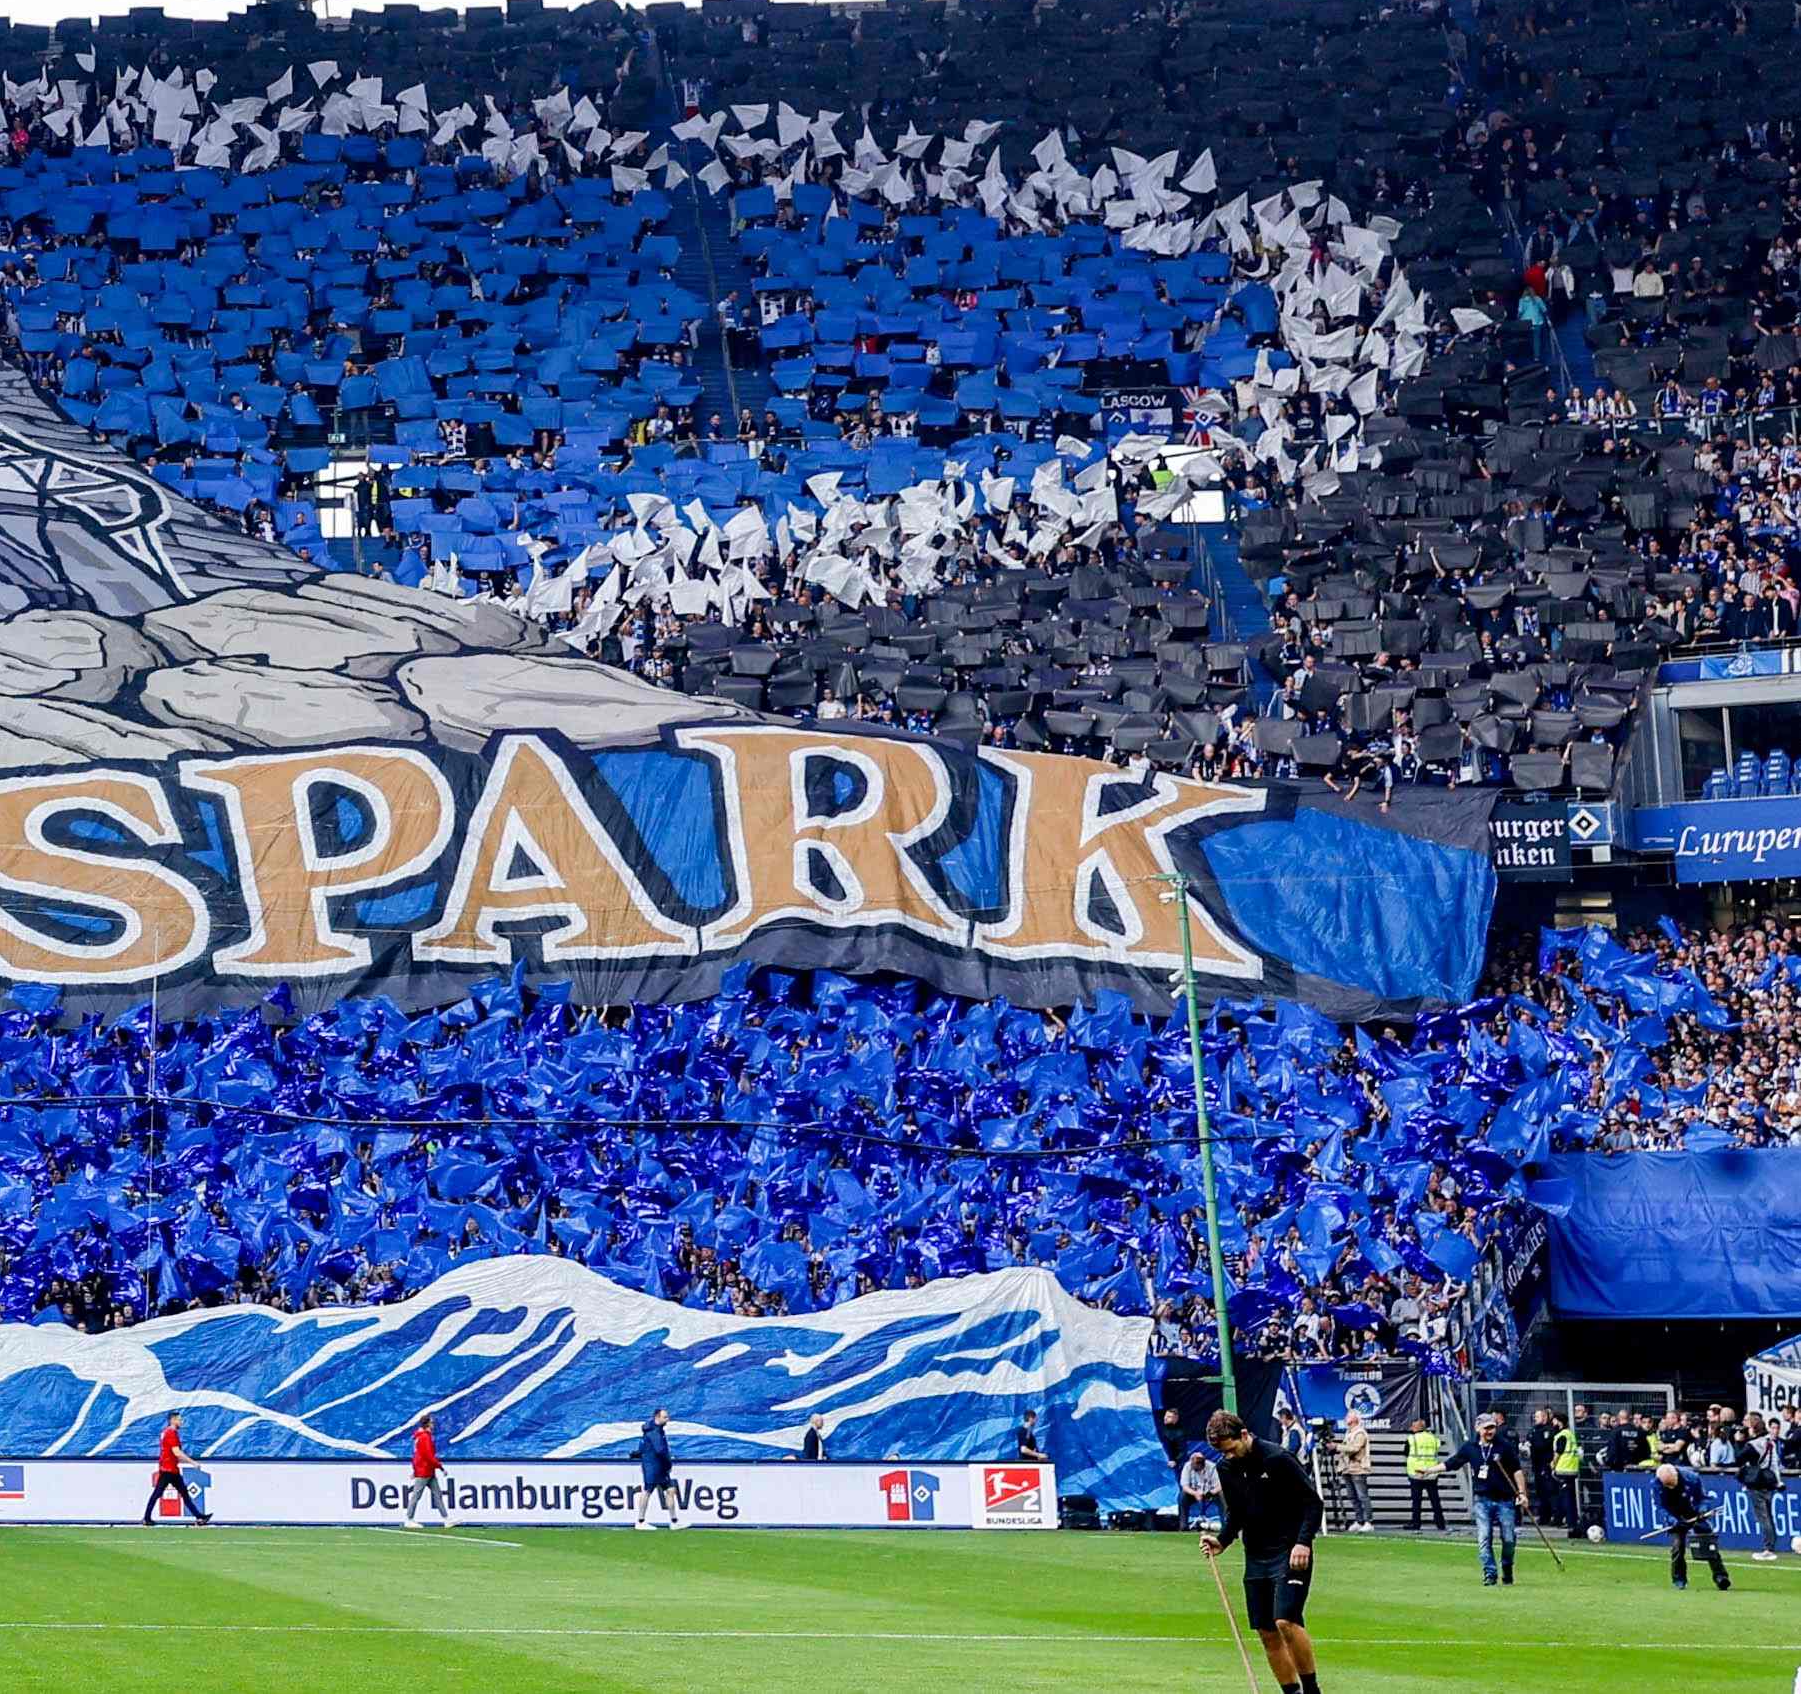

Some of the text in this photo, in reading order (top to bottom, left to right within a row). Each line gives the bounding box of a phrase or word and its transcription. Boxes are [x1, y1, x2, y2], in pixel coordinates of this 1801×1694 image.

[1100, 394, 1167, 409] LASGOW
[1759, 1373, 1801, 1414] Her
[351, 1476, 739, 1519] Der Hamburger Weg
[1610, 1486, 1644, 1529] EIN
